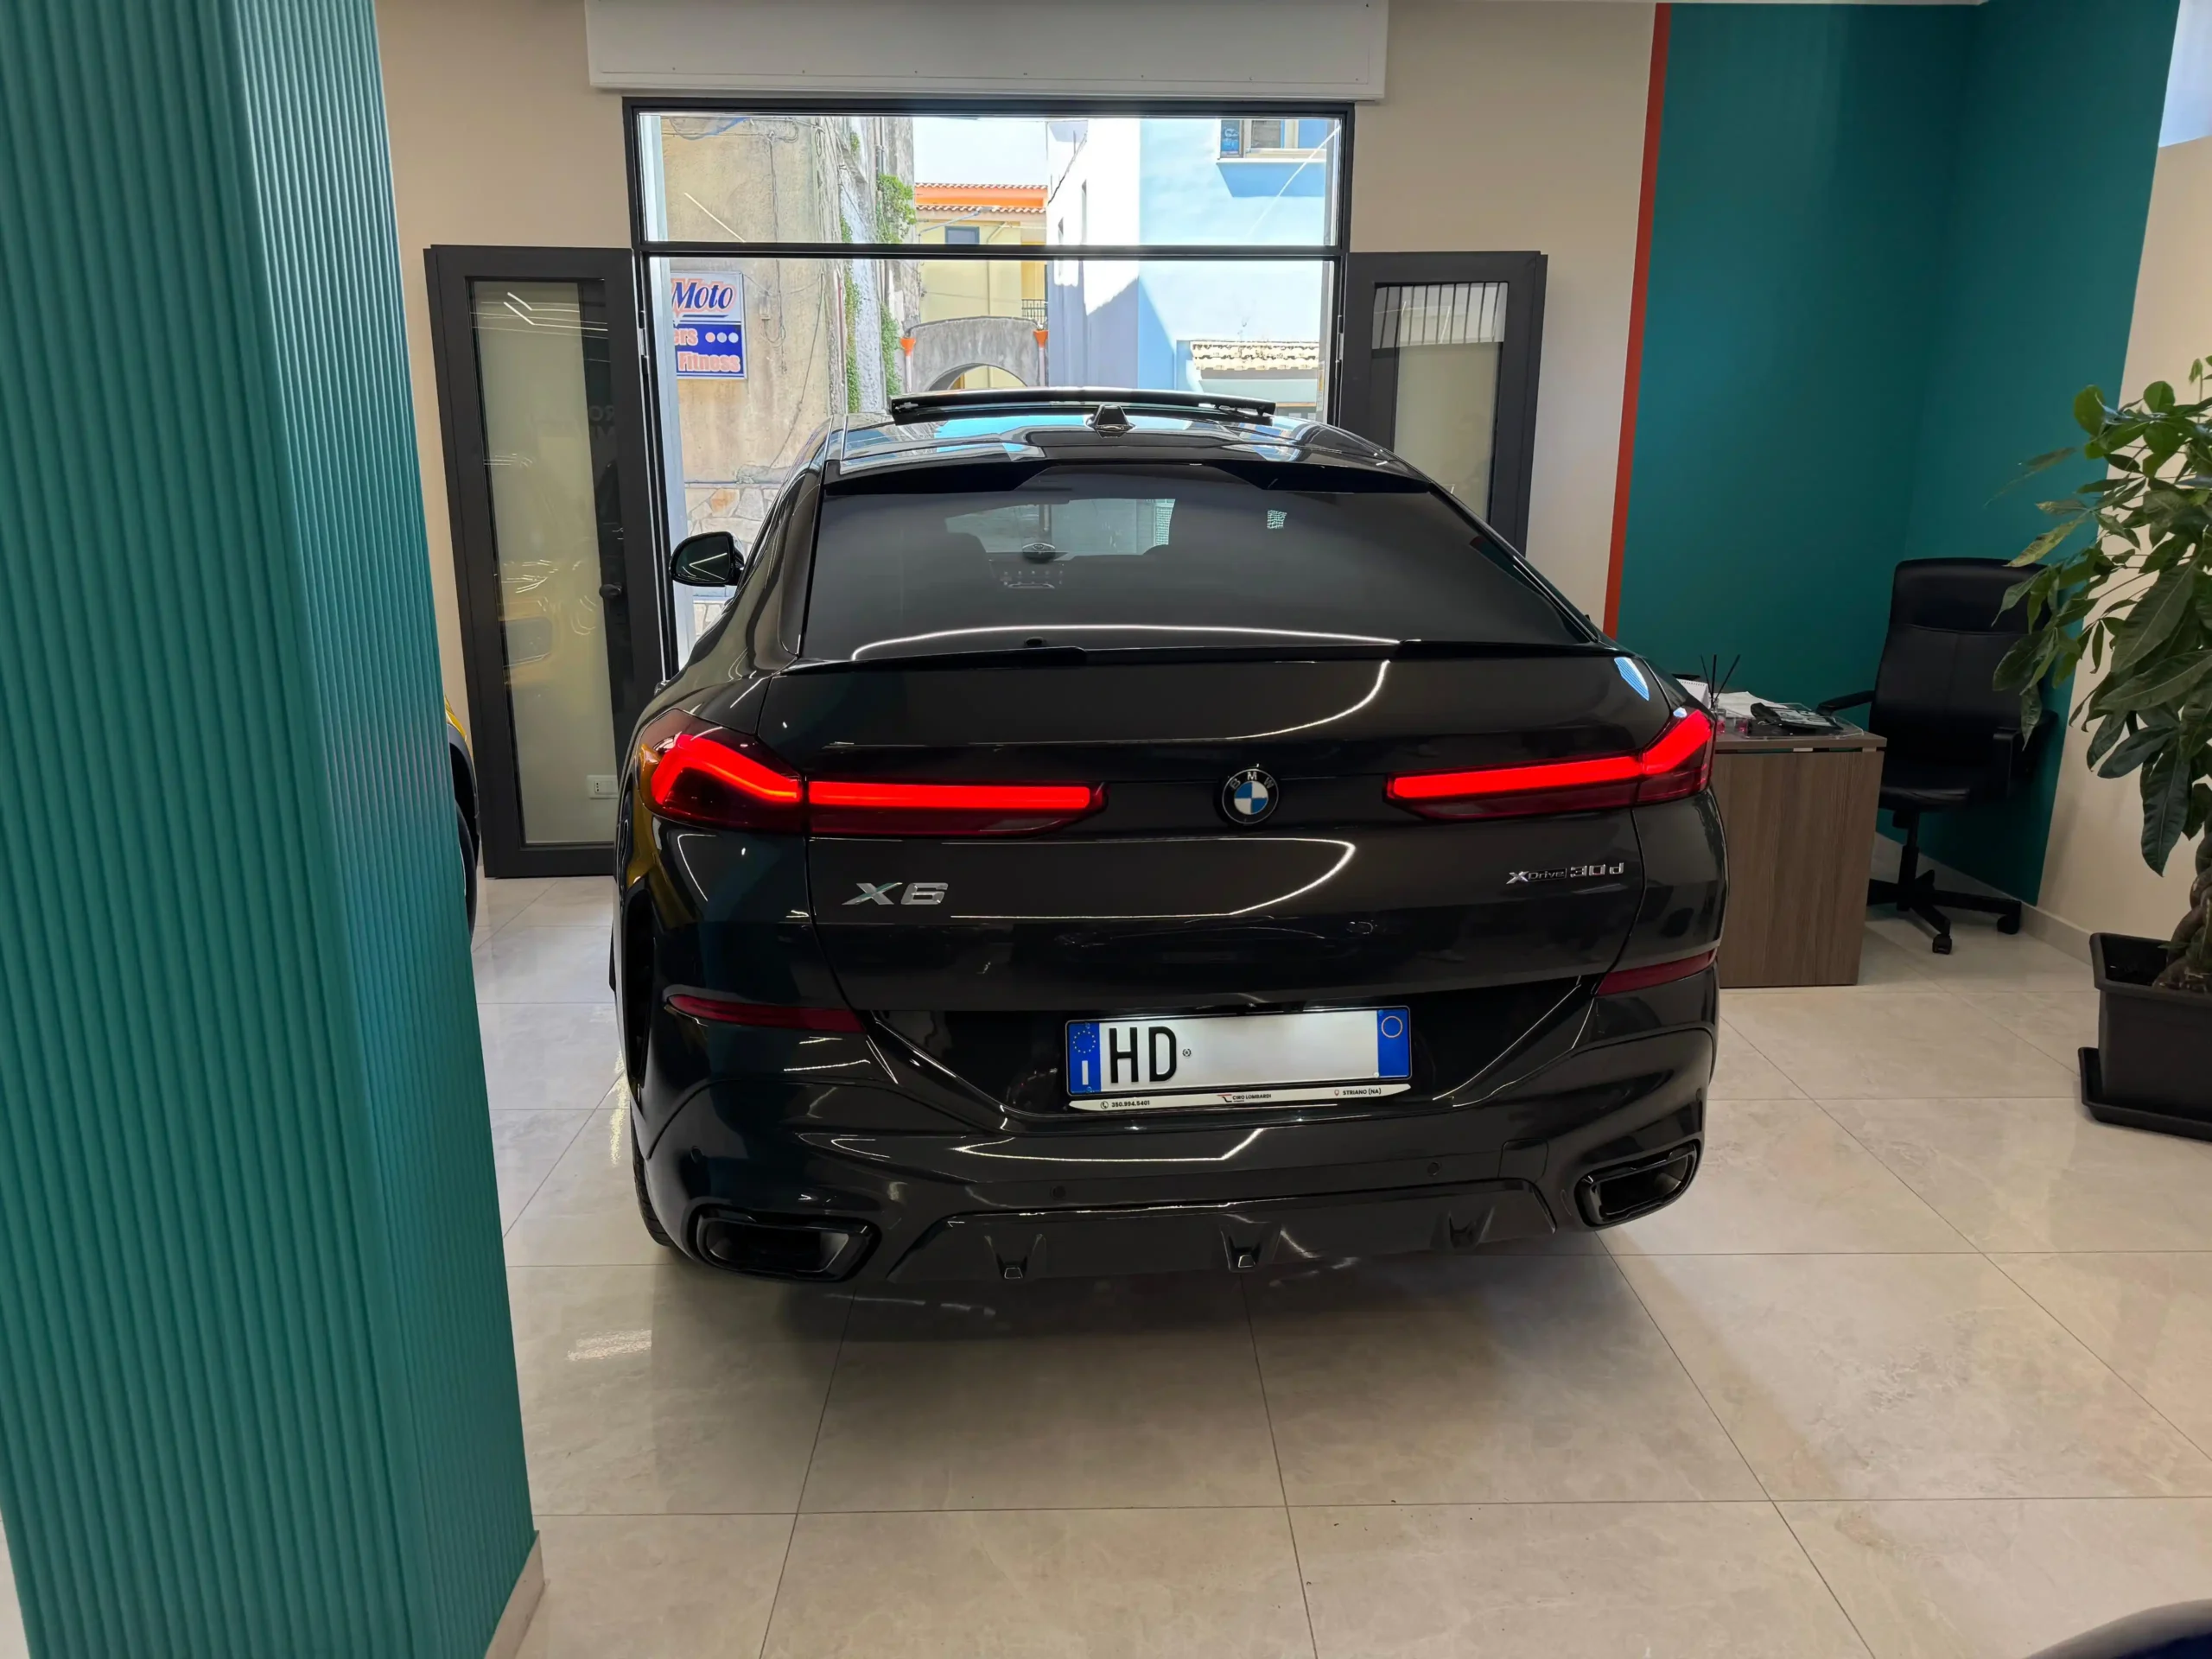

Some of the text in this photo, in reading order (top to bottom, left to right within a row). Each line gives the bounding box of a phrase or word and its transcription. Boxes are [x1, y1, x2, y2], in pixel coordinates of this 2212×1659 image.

[671, 281, 734, 309] Moto
[677, 352, 741, 372] Fitness
[1230, 772, 1274, 789] BMW
[842, 882, 949, 905] X6
[1109, 1026, 1177, 1084] HD
